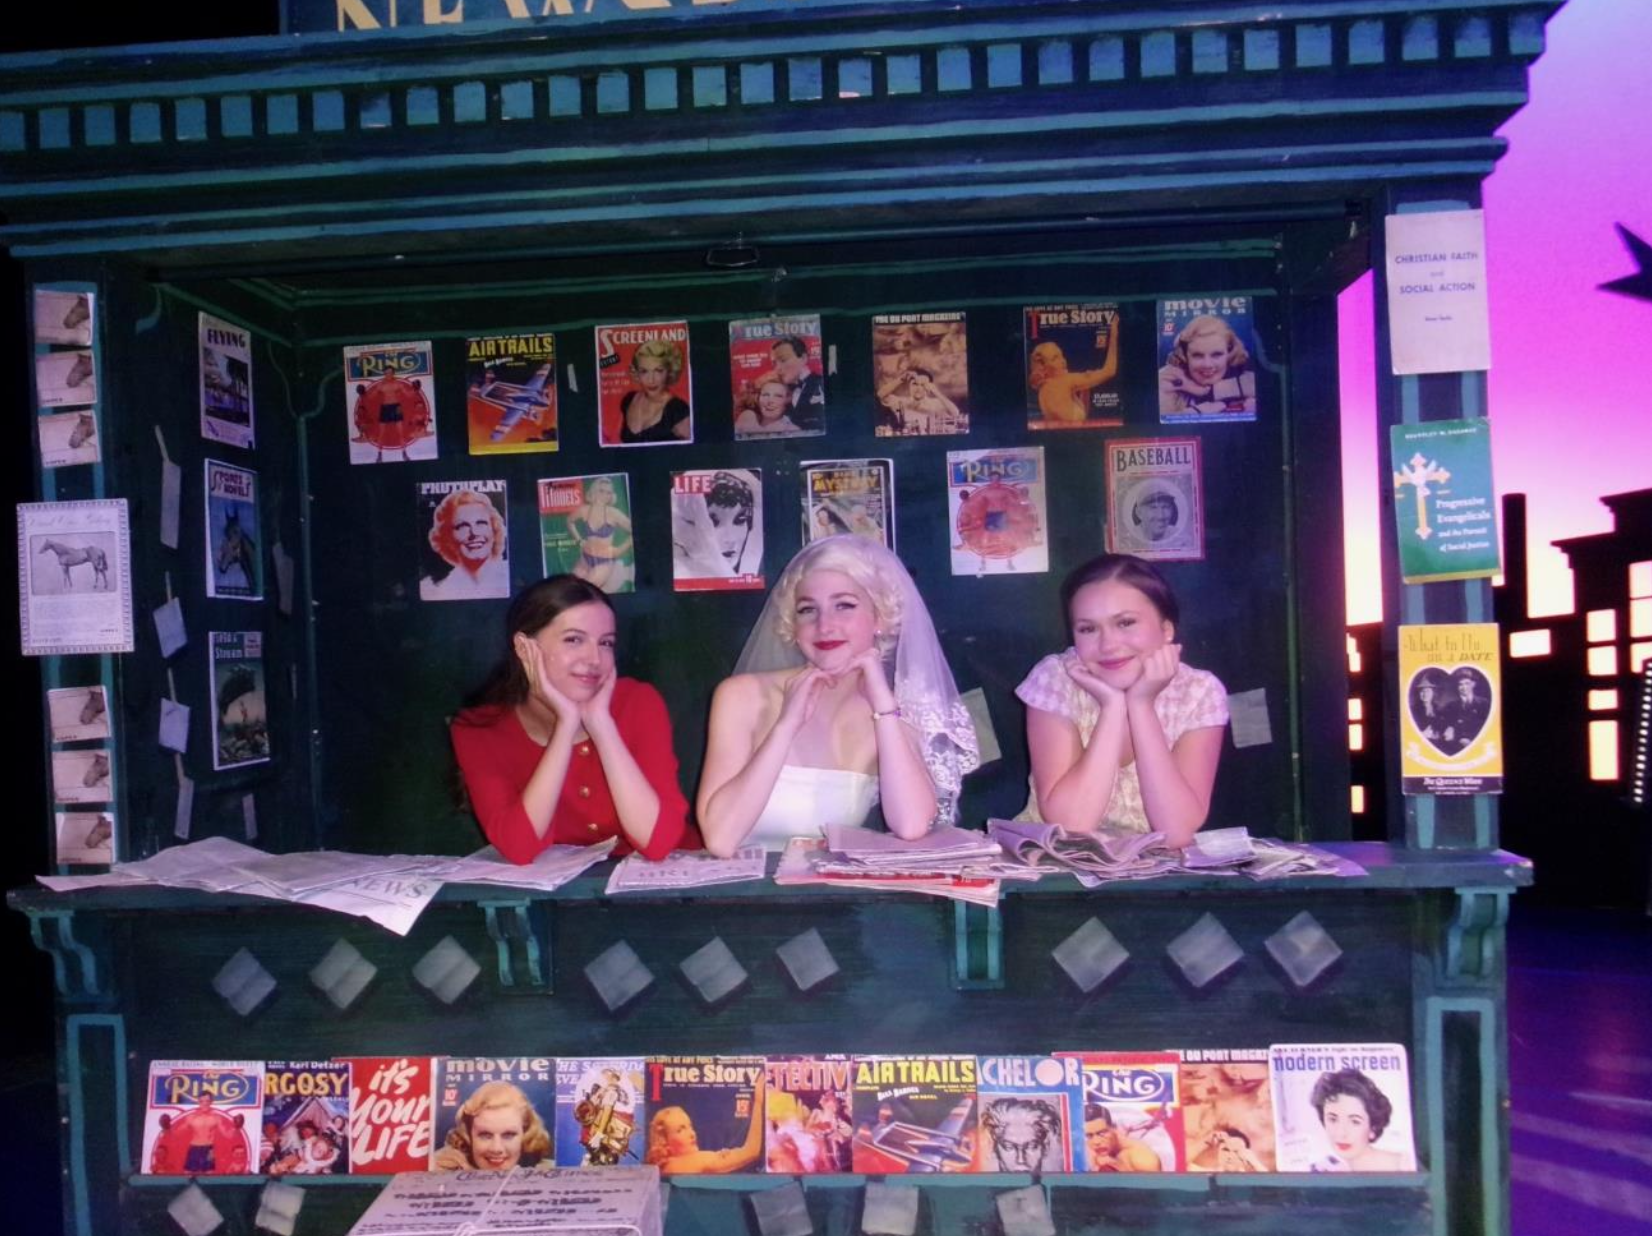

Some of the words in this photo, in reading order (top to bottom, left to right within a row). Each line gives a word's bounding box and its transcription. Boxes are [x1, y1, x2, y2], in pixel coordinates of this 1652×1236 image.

[1394, 252, 1447, 264] CHRISTIAN
[1450, 251, 1479, 260] FAITH
[1399, 284, 1434, 294] SOCIAL
[1439, 282, 1475, 292] ACTION
[1164, 297, 1246, 311] movie
[1070, 309, 1115, 324] Story
[207, 328, 246, 348] FLYING
[468, 340, 497, 357] AIR
[497, 337, 552, 355] TRAILS
[1116, 447, 1191, 471] BASEBALL
[675, 476, 712, 494] LIFE
[1459, 652, 1494, 661] DATE
[446, 1057, 550, 1073] movie
[557, 1060, 580, 1071] HE
[856, 1061, 894, 1083] AIR
[897, 1060, 976, 1082] TRAILS
[977, 1057, 1081, 1087] CHELOR
[1341, 1056, 1402, 1072] screen
[368, 1059, 419, 1095] it's
[445, 1073, 549, 1082] MIRROR
[649, 1064, 700, 1102] True
[703, 1064, 760, 1086] Story
[1082, 1070, 1156, 1098] RING
[165, 1074, 241, 1104] RING
[352, 1120, 430, 1166] LIFE
